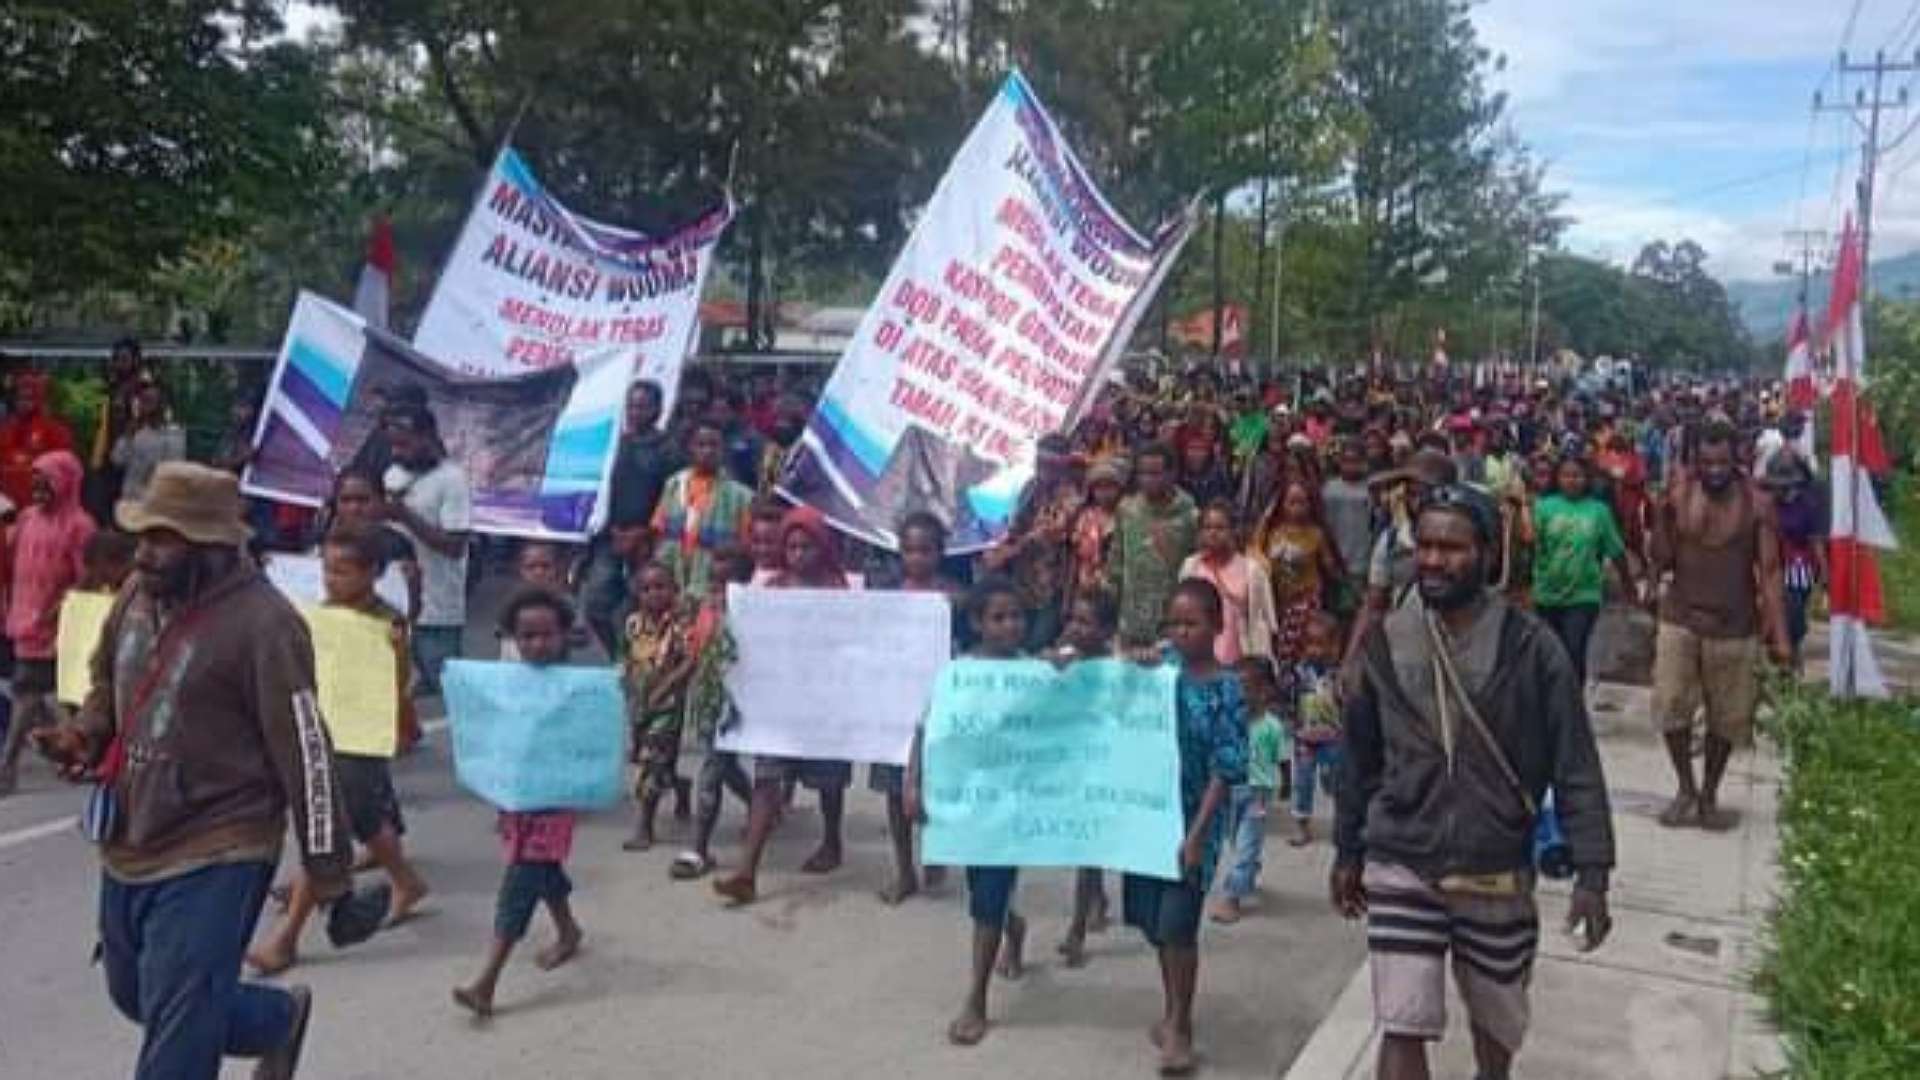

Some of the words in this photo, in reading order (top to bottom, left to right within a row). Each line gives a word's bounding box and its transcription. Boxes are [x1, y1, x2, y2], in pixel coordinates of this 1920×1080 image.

[481, 234, 600, 302] ALIANSI
[498, 299, 600, 341] MENOLAK
[901, 337, 958, 381] ATAS
